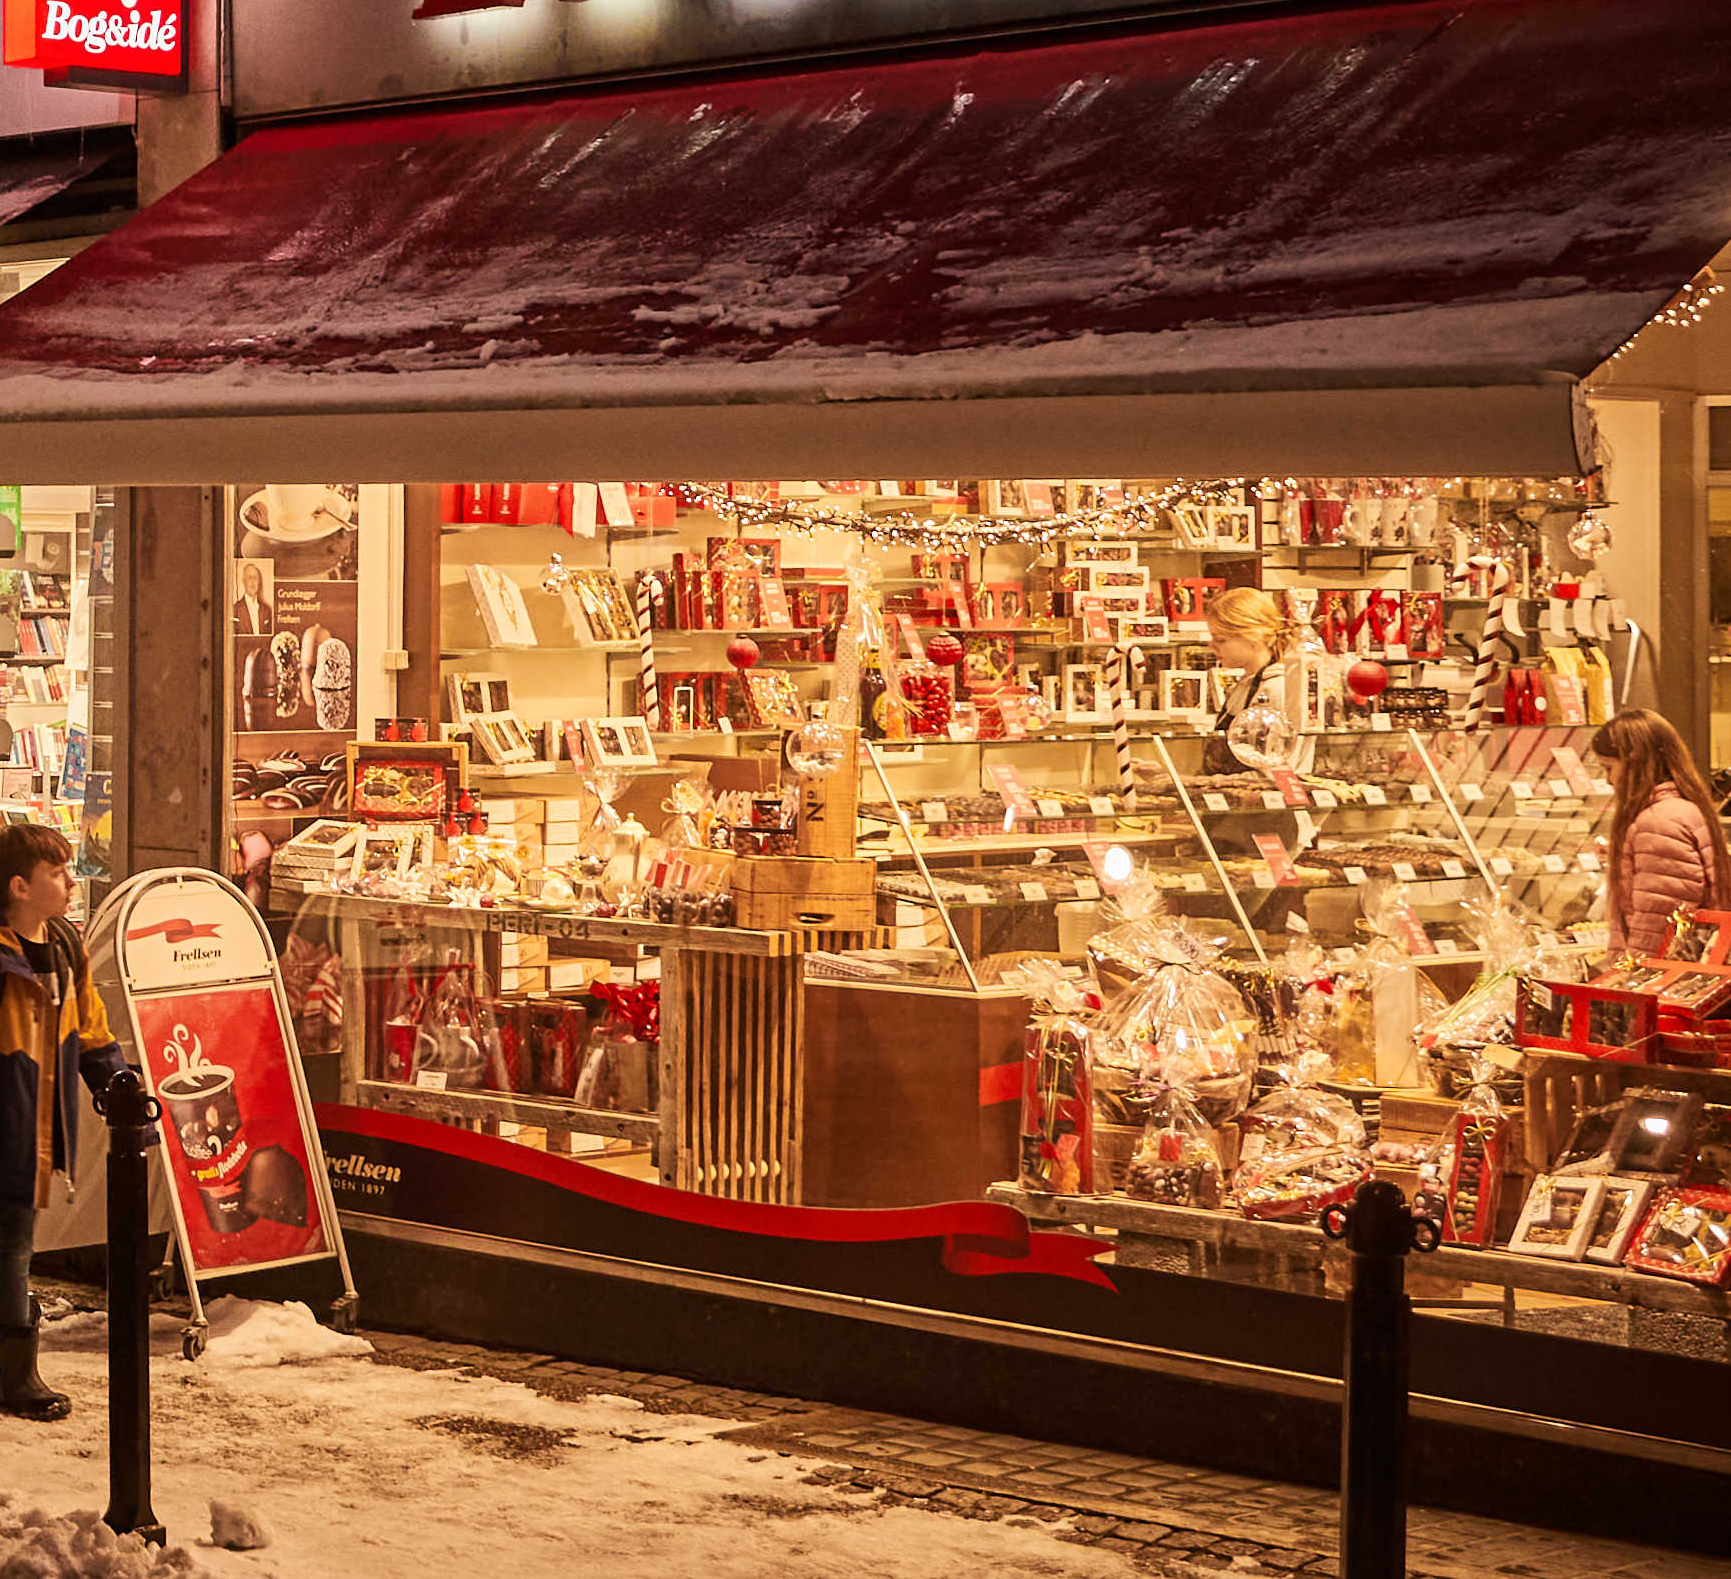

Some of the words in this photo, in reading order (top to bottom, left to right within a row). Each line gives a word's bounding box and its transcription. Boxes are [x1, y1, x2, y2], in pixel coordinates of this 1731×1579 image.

[42, 0, 177, 53] Bog&idé
[173, 947, 222, 962] Frellsen
[324, 1152, 402, 1183] rellsen
[332, 1178, 356, 1191] DEN
